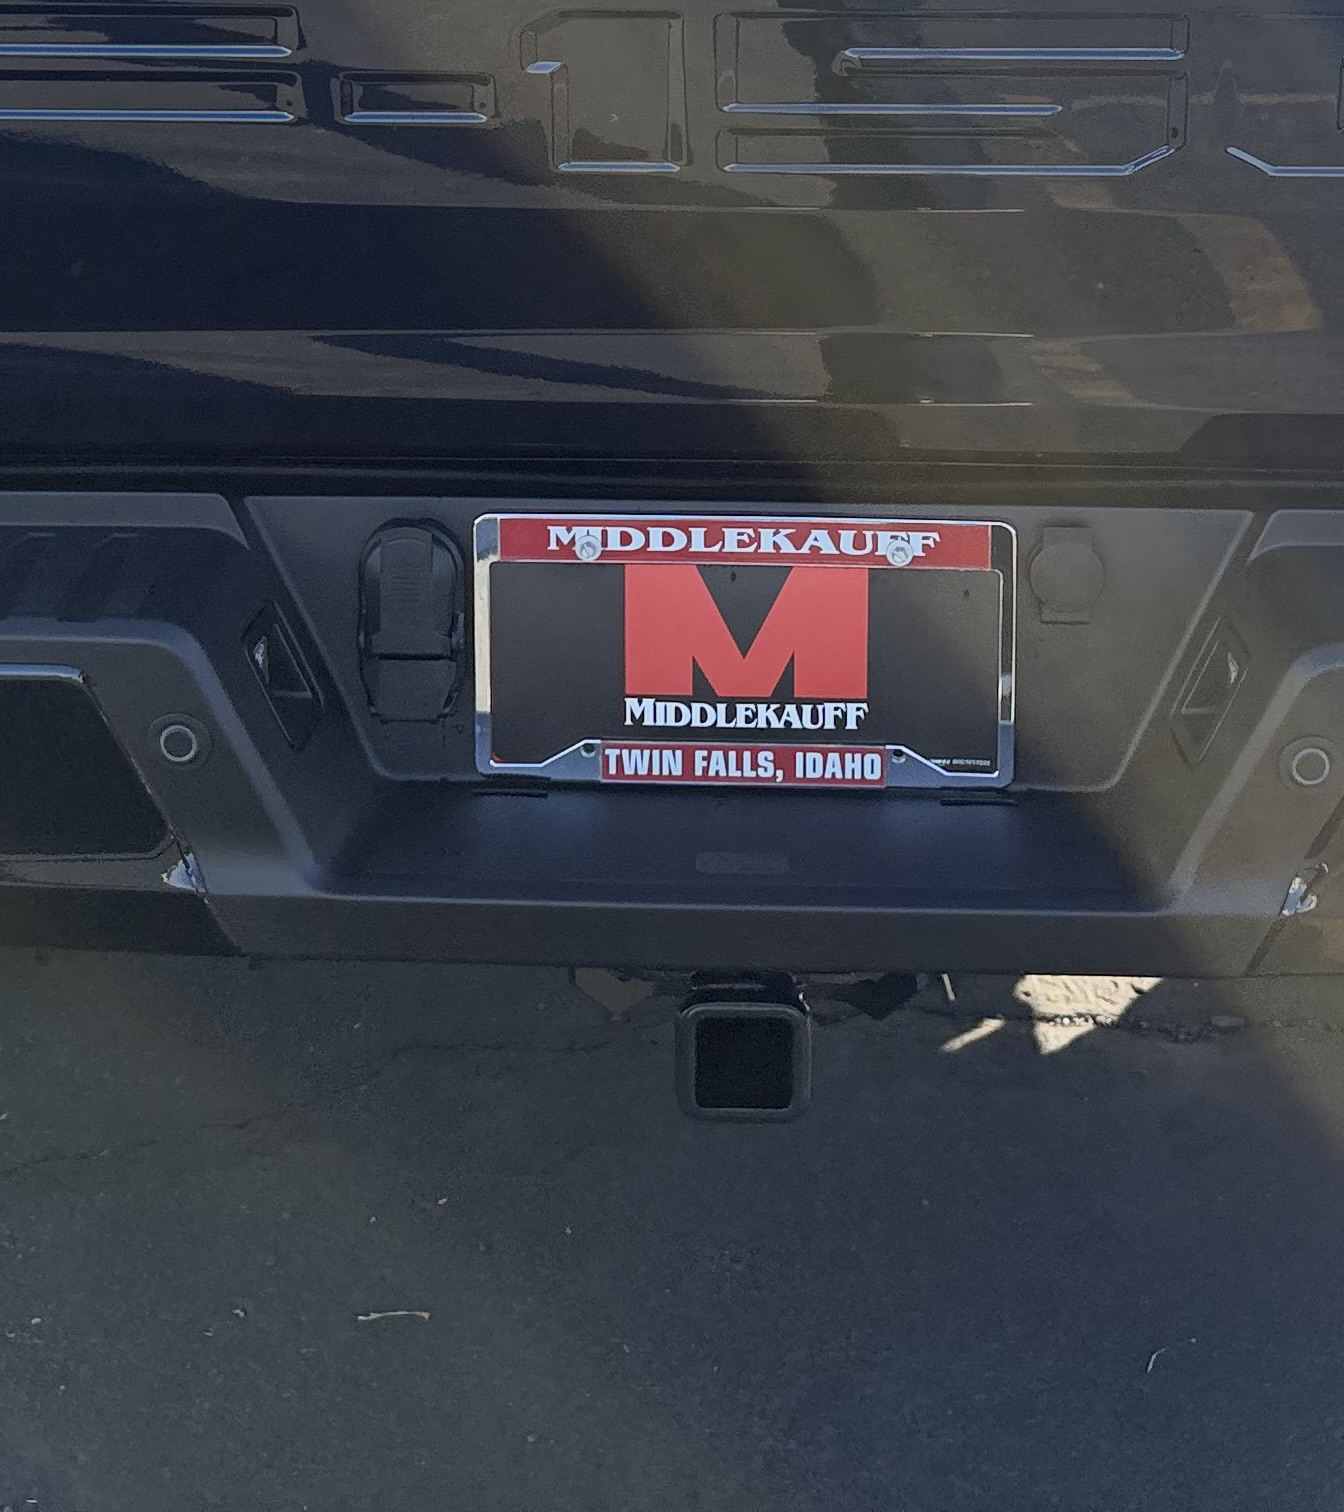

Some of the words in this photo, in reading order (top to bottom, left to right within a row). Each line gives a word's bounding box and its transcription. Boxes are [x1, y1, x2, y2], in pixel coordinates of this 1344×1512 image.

[547, 525, 941, 558] MIDDLEKAUFF
[624, 563, 869, 699] M
[623, 697, 869, 731] MIDDLEKAUFF
[604, 748, 684, 778] TWIN
[694, 749, 785, 783] FALLS,
[795, 751, 882, 781] IDAHO
